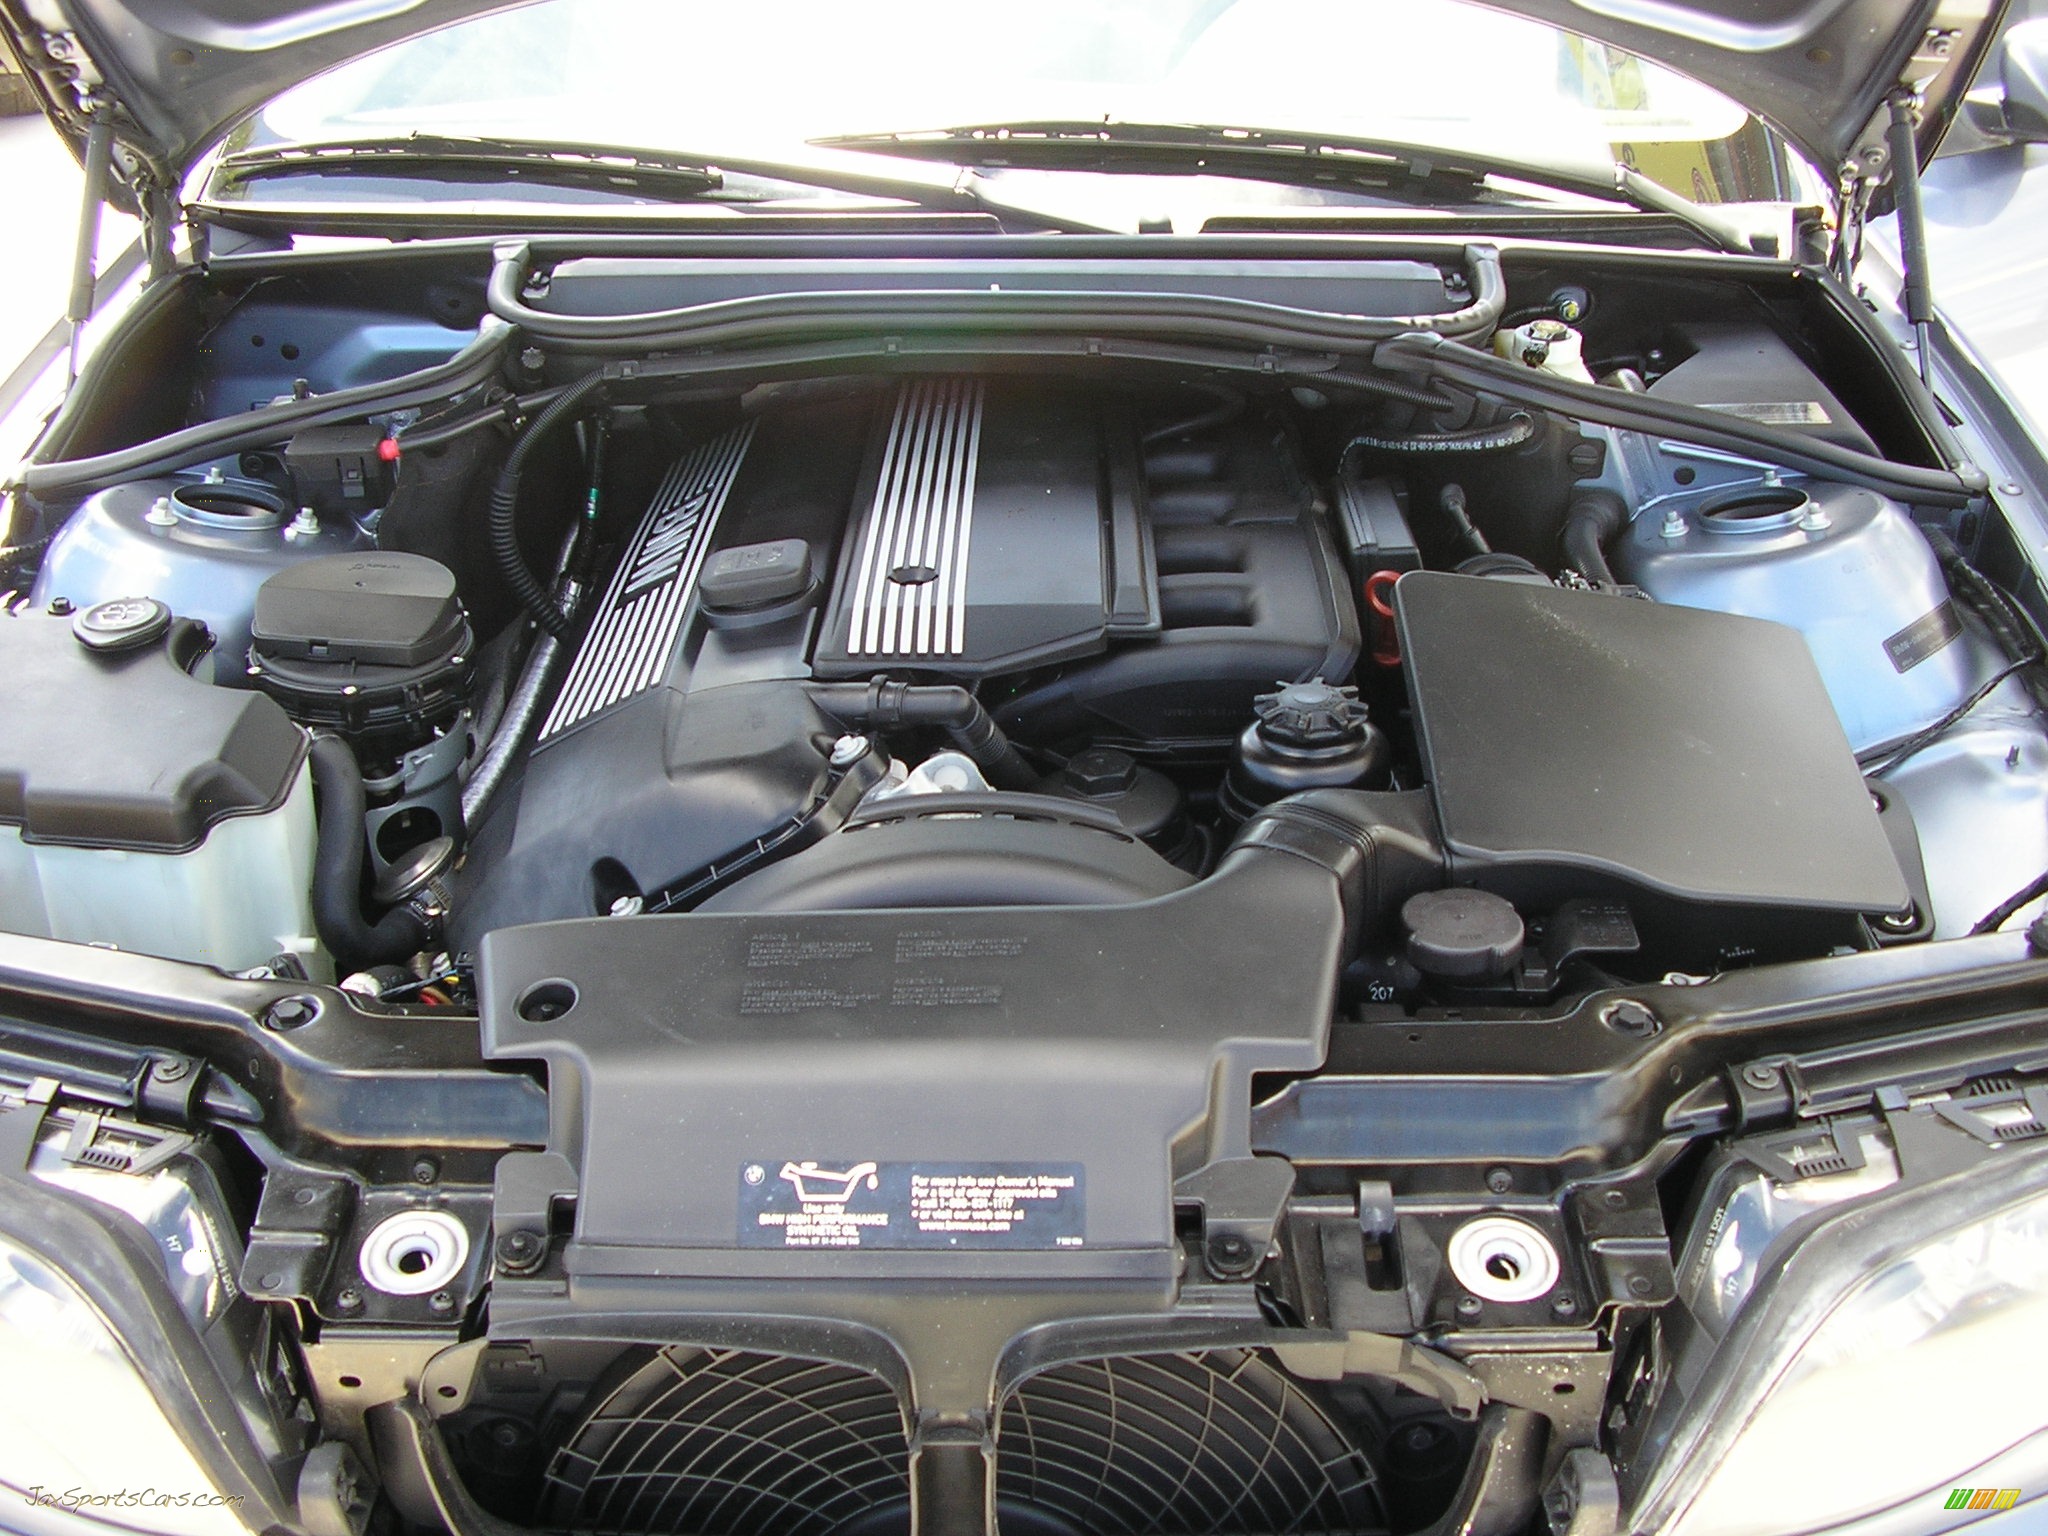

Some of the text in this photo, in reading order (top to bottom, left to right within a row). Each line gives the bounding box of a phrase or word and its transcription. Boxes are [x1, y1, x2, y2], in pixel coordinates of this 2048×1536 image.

[625, 493, 709, 594] BMW
[1371, 986, 1394, 1000] 207
[759, 1213, 786, 1225] BMW
[812, 1213, 889, 1225] PERFORMANCE
[786, 1225, 860, 1236] SYNTHETIC OIL
[166, 1234, 183, 1252] H7
[1724, 1276, 1739, 1297] H7
